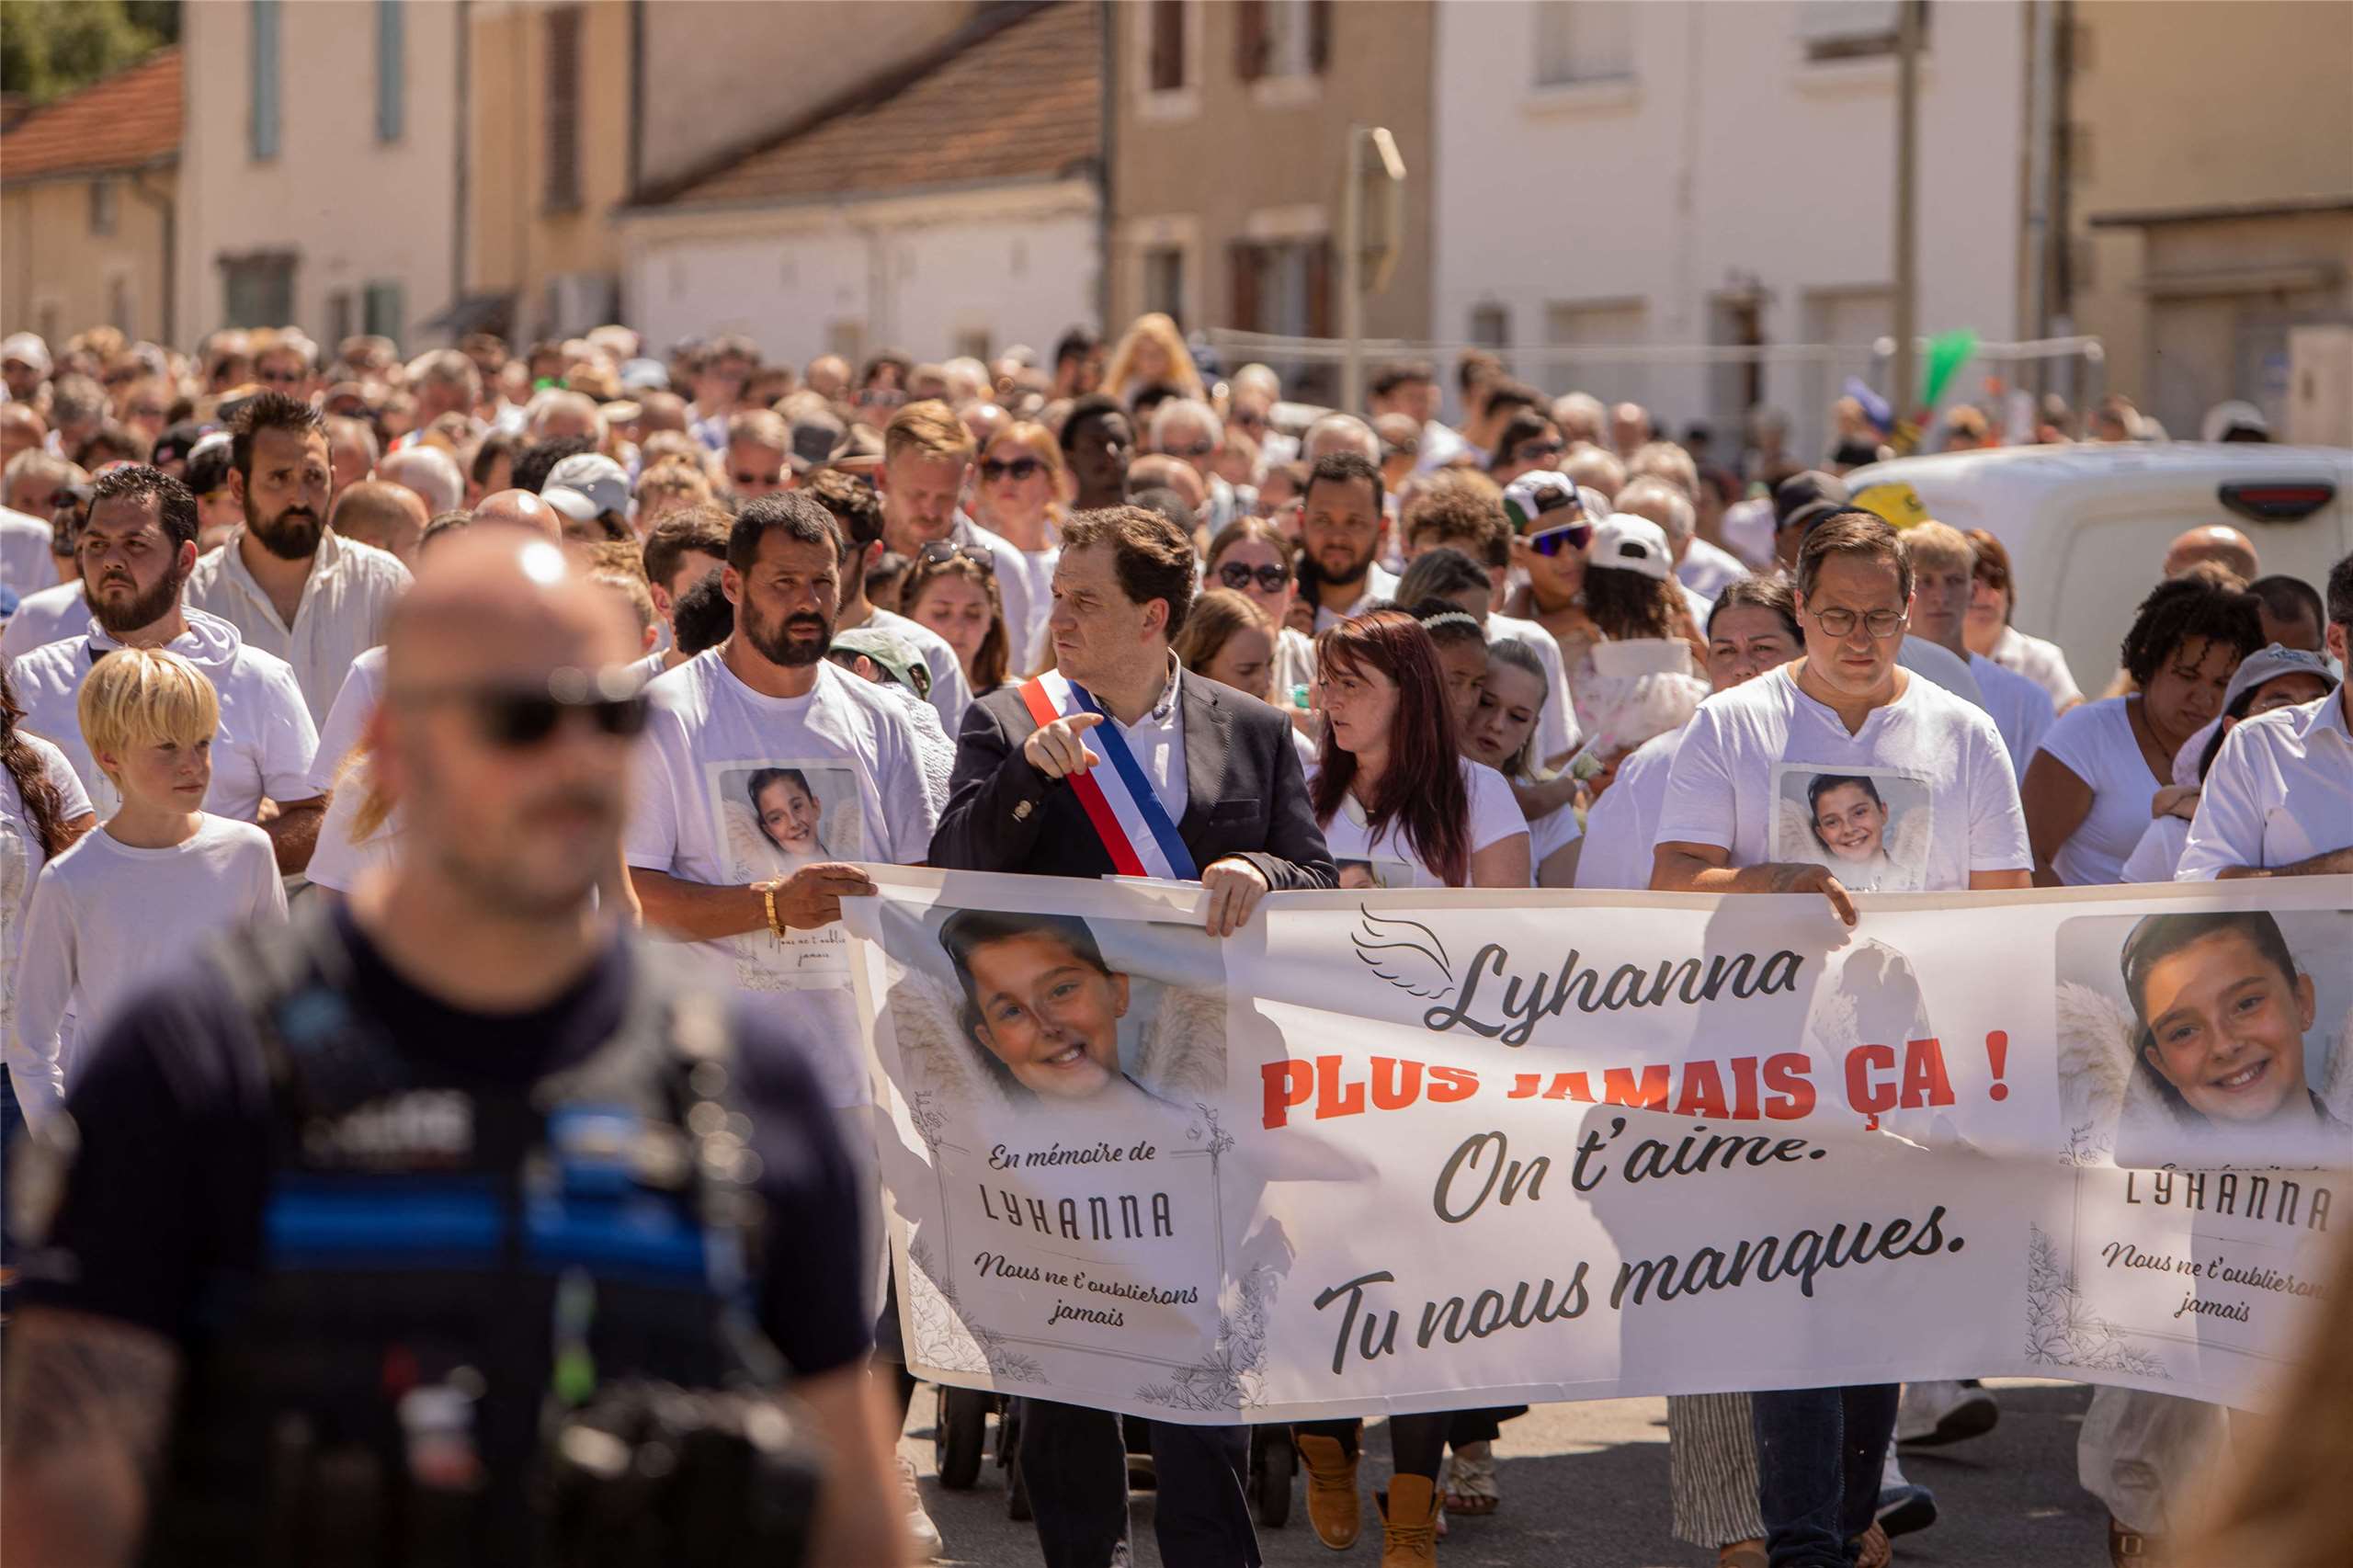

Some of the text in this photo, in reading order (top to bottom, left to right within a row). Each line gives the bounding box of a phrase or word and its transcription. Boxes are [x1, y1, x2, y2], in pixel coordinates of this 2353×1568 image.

[1424, 944, 1804, 1047] Lyhanna
[1261, 1029, 2010, 1132] PLUS JAMAIS ÇA !
[988, 1140, 1156, 1170] En mémoire de
[1434, 1116, 1827, 1224] On t'aime.
[979, 1184, 1174, 1241] LYHANNA
[2126, 1171, 2333, 1232] LYHANNA
[973, 1251, 1041, 1282] Nous
[1044, 1272, 1069, 1288] ne
[2101, 1242, 2172, 1273] Nous
[2176, 1258, 2202, 1278] ne
[1047, 1299, 1125, 1328] jamais
[1313, 1205, 1966, 1376] Tu nous manques.
[2173, 1290, 2251, 1324] jamais
